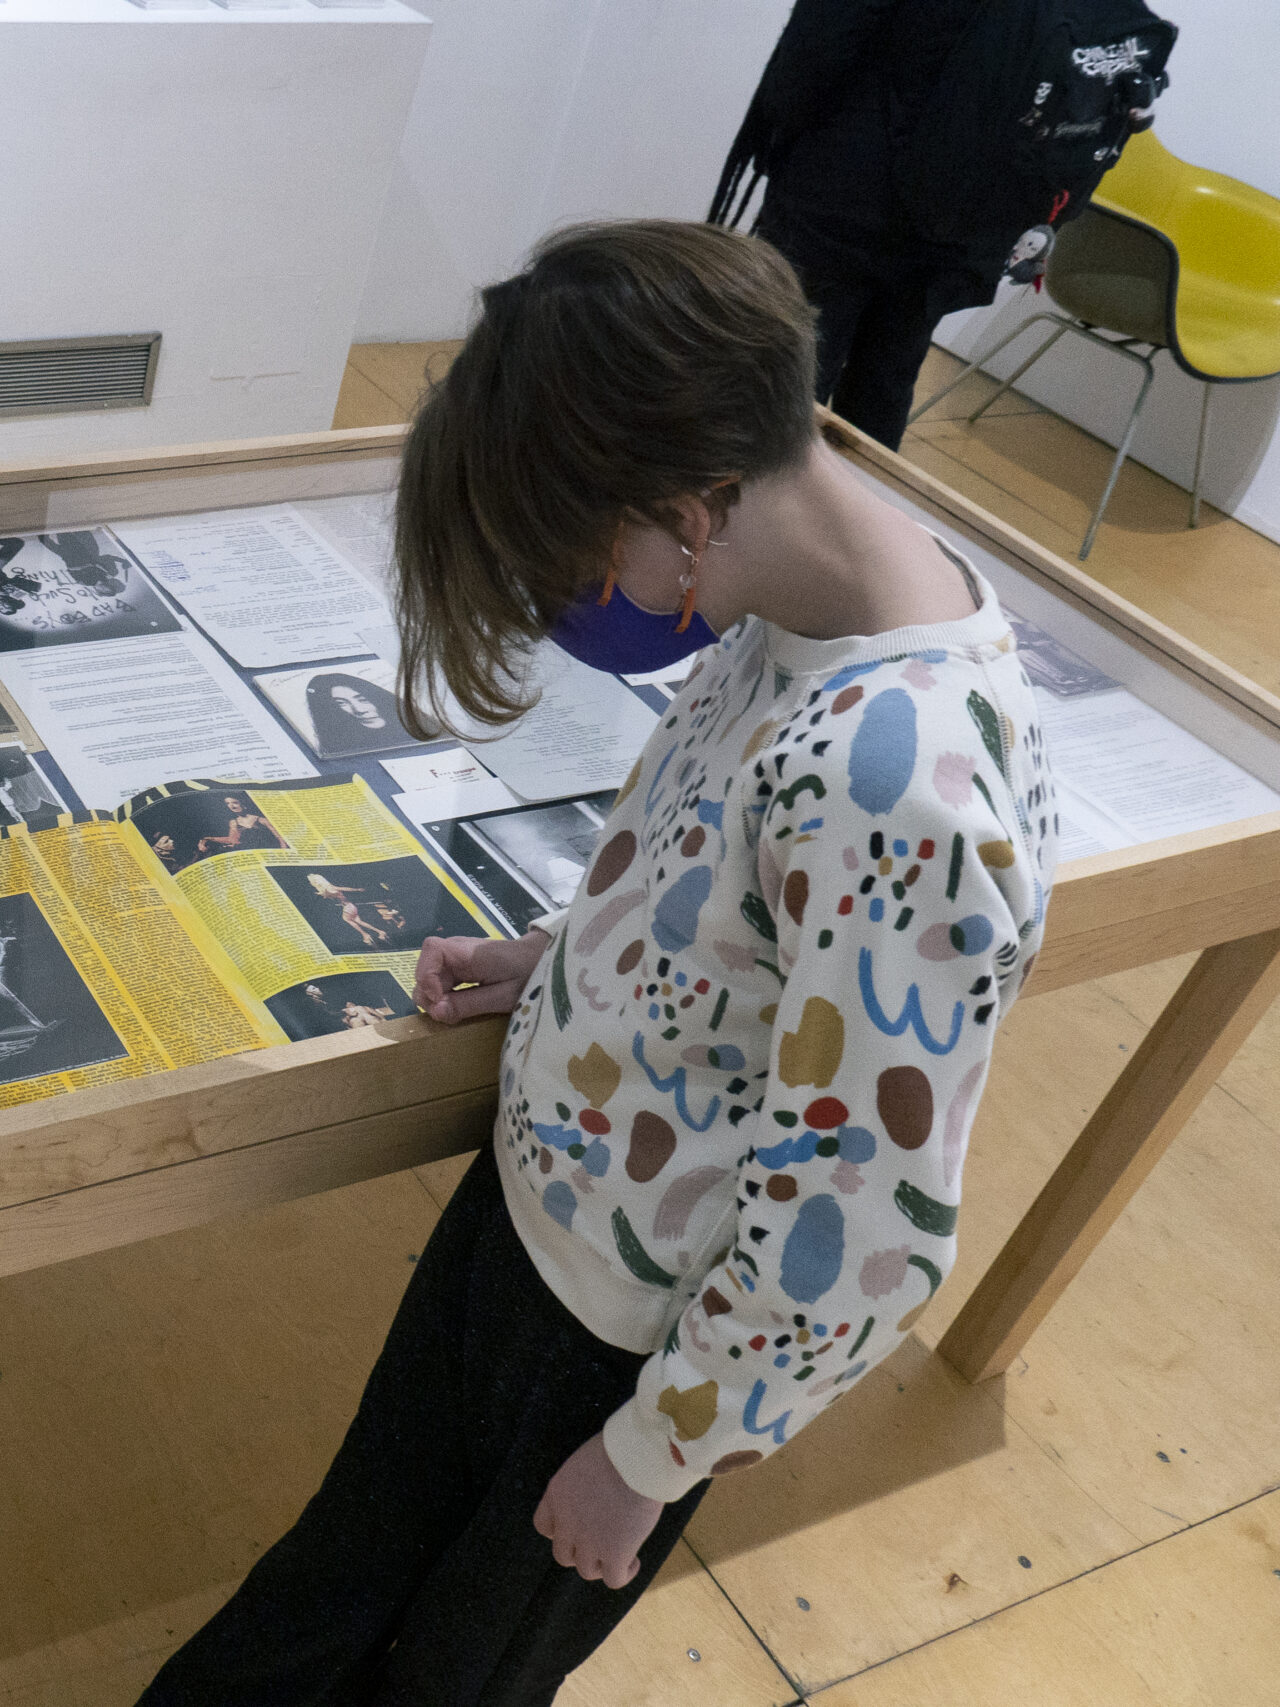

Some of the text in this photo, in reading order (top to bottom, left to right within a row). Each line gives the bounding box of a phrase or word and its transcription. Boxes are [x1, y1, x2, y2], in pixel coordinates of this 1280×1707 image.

[11, 567, 76, 586] Thing
[28, 587, 77, 607] Such
[91, 599, 136, 617] BAD
